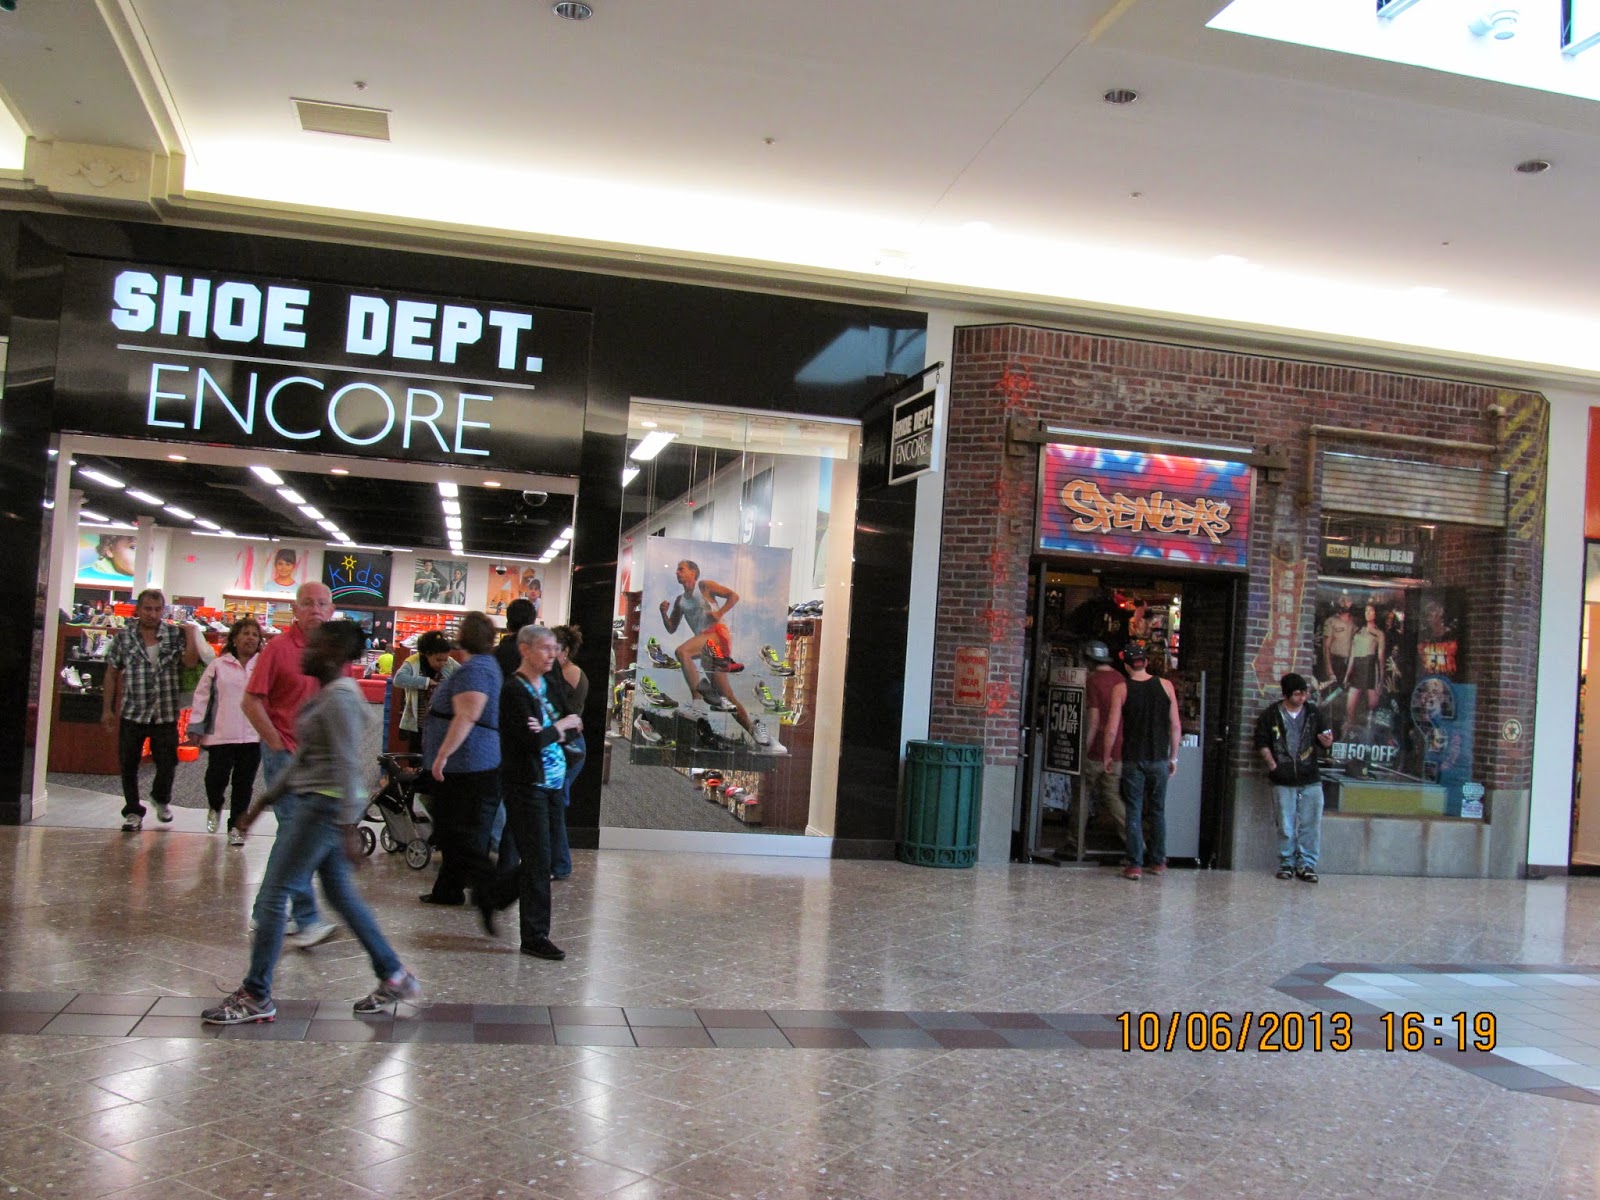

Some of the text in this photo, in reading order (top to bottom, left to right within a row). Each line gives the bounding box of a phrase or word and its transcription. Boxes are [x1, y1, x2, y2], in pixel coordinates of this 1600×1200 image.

[111, 271, 543, 373] SHOE DEPT.
[146, 363, 494, 456] ENCORE
[894, 405, 933, 440] SHOE DEPT.
[895, 434, 929, 465] ENCORE
[1350, 546, 1390, 562] WALKING
[1390, 549, 1414, 564] DEAD
[1067, 721, 1079, 734] OFF
[1371, 745, 1396, 762] OFF
